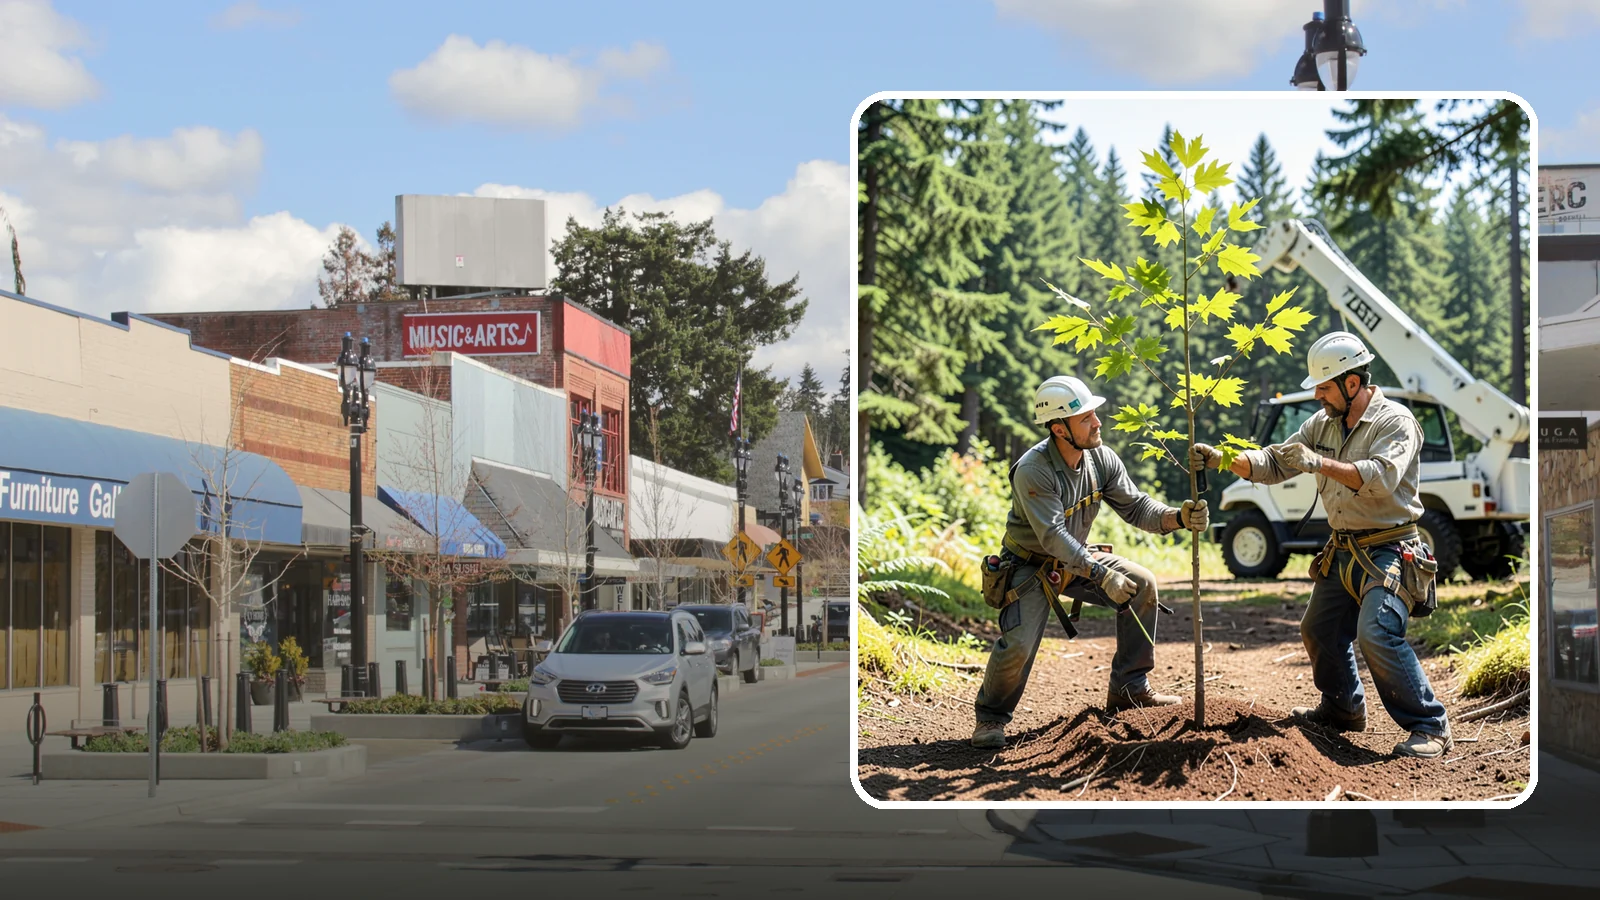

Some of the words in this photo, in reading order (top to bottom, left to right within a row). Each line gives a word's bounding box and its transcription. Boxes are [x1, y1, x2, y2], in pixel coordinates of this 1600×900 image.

[409, 323, 519, 348] MUSIC&ARTS
[0, 472, 79, 515] Furniture
[90, 483, 122, 519] Gal
[453, 563, 479, 573] SUSHI
